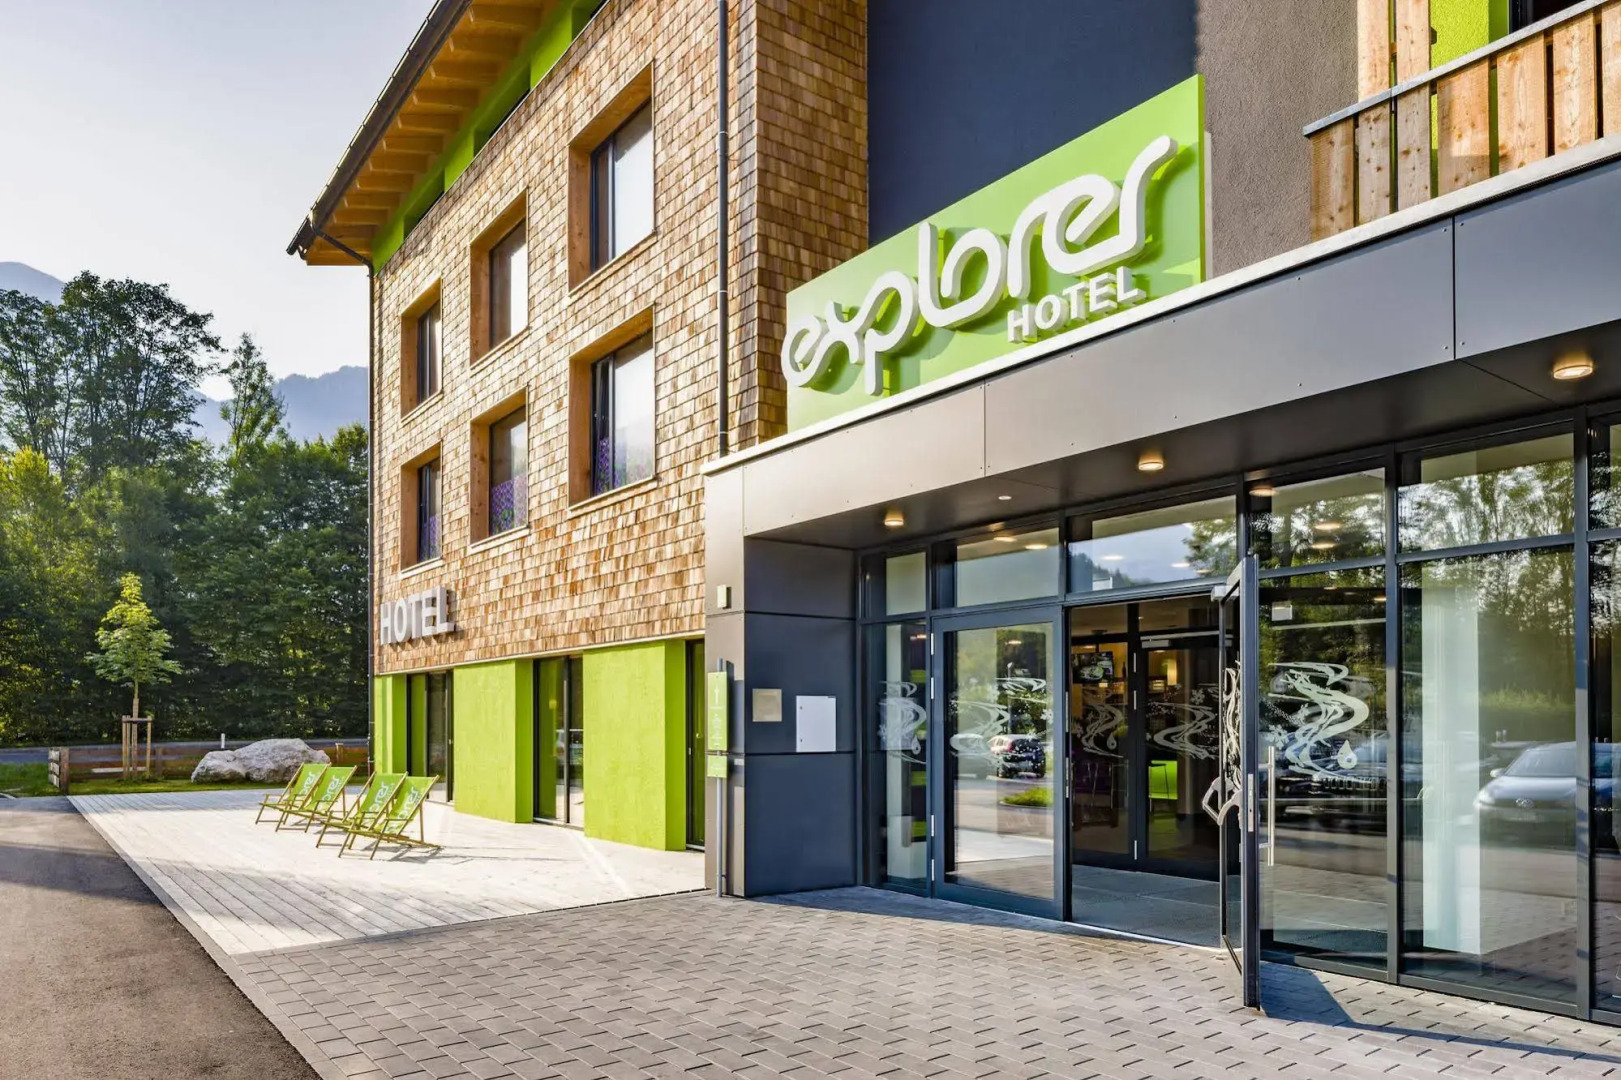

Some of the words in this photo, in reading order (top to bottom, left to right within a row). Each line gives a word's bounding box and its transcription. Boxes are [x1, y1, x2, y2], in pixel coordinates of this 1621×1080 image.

[781, 134, 1178, 396] explorer
[1007, 266, 1147, 344] HOTEL
[380, 586, 455, 646] HOTEL
